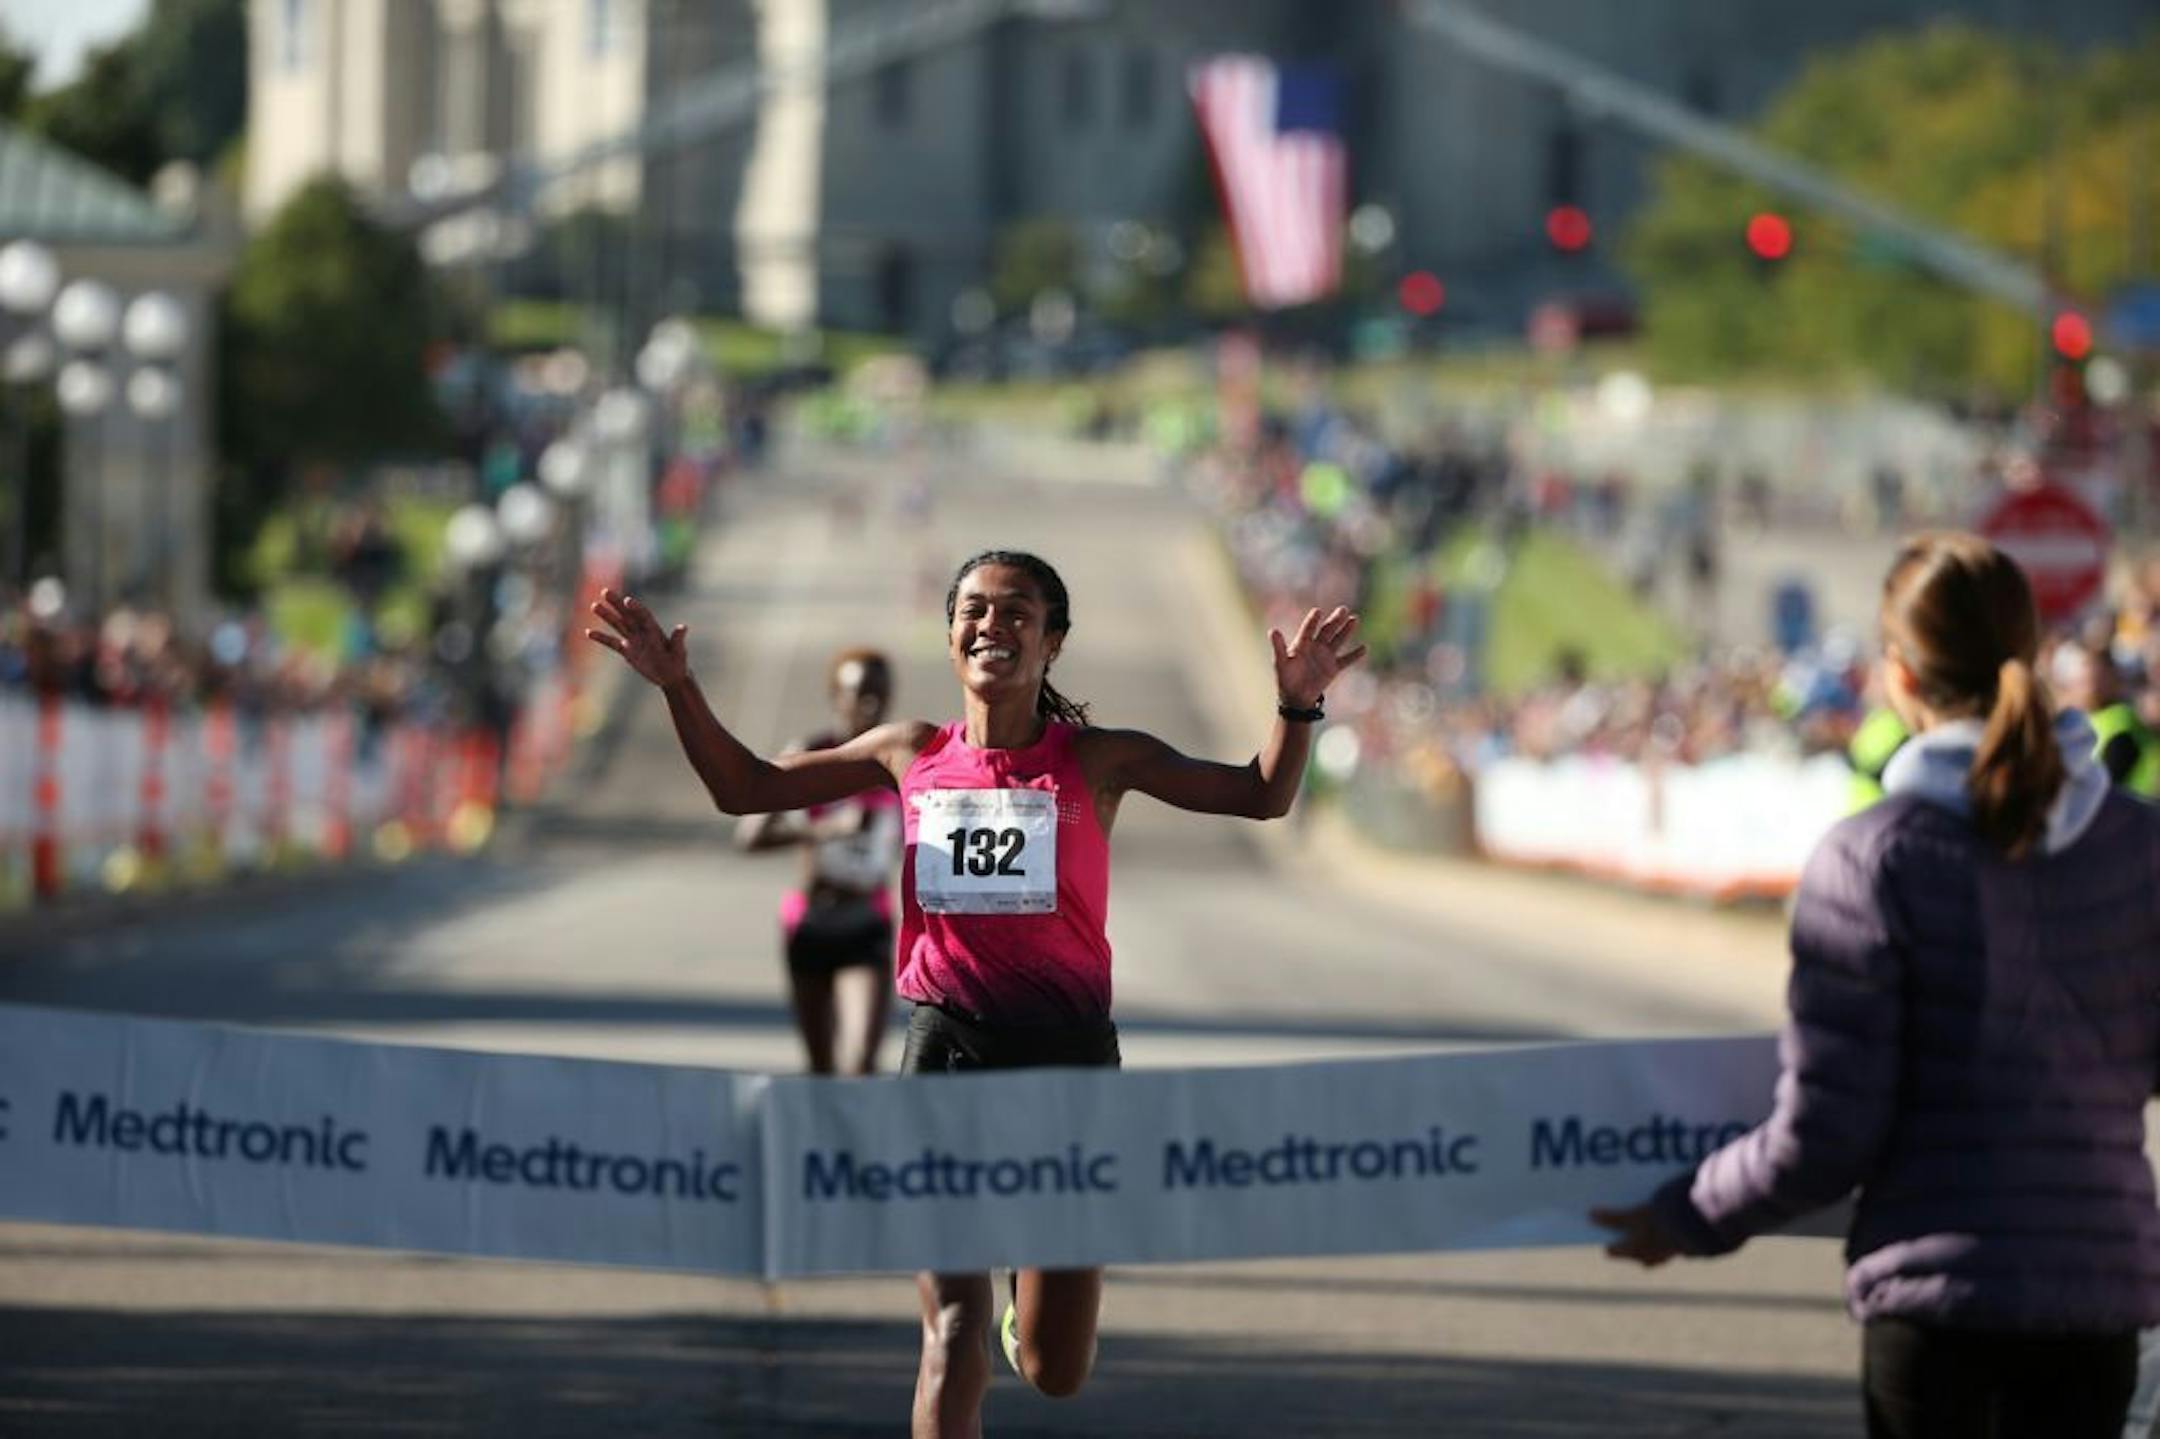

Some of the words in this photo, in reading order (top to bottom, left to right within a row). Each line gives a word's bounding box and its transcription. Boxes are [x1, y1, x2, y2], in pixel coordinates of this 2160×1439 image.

[947, 827, 1025, 877] 132
[54, 1091, 369, 1171] Medtronic
[424, 1124, 739, 1202] Medtronic
[803, 1143, 1117, 1201] Medtronic
[1163, 1125, 1477, 1189] Medtronic
